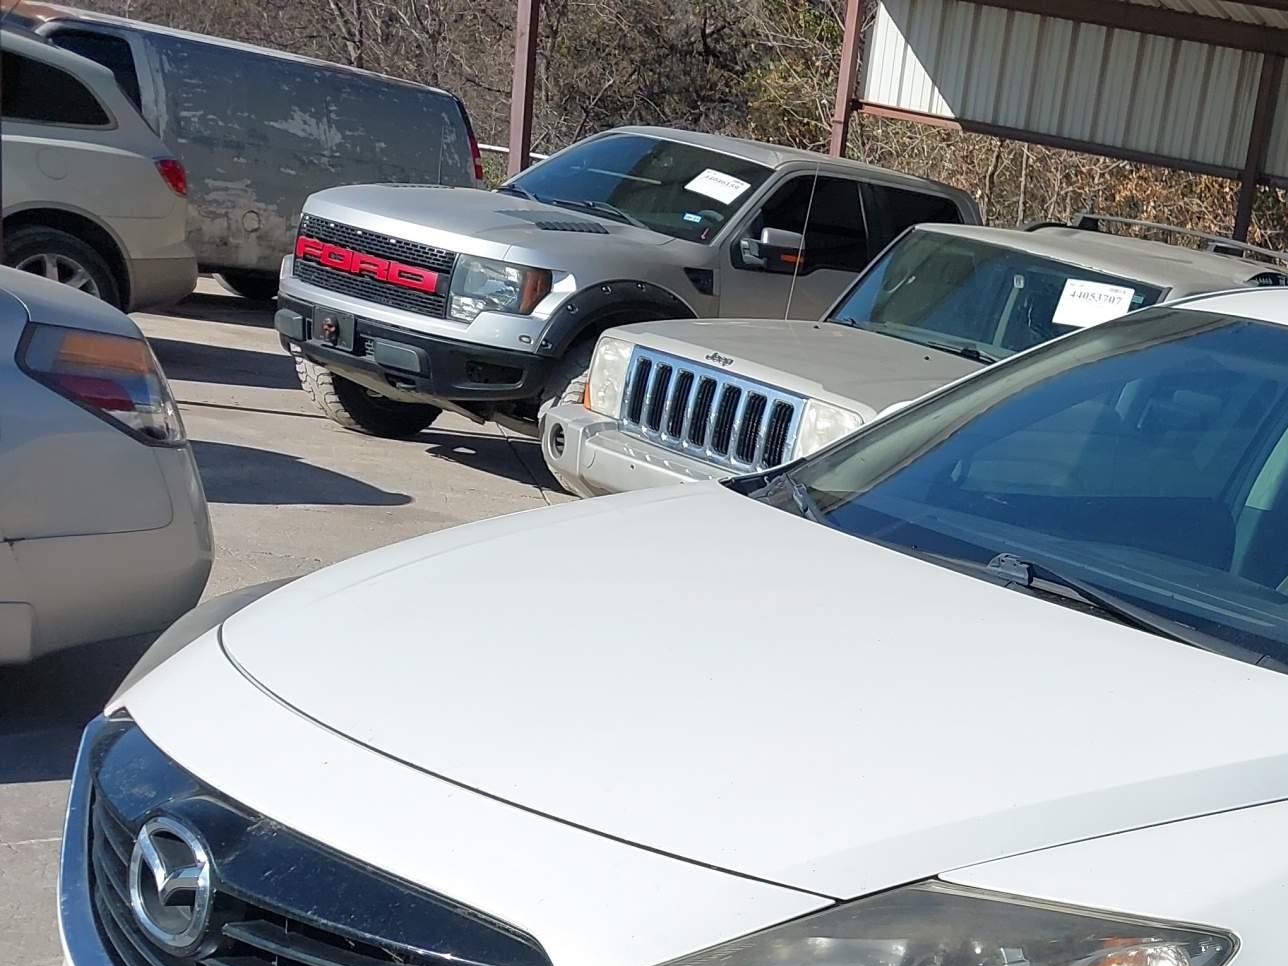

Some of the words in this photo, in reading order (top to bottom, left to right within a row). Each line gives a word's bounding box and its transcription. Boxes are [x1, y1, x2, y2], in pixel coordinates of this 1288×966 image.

[296, 235, 440, 293] FORD
[1069, 290, 1123, 305] 44053707
[705, 352, 734, 367] Jeep
